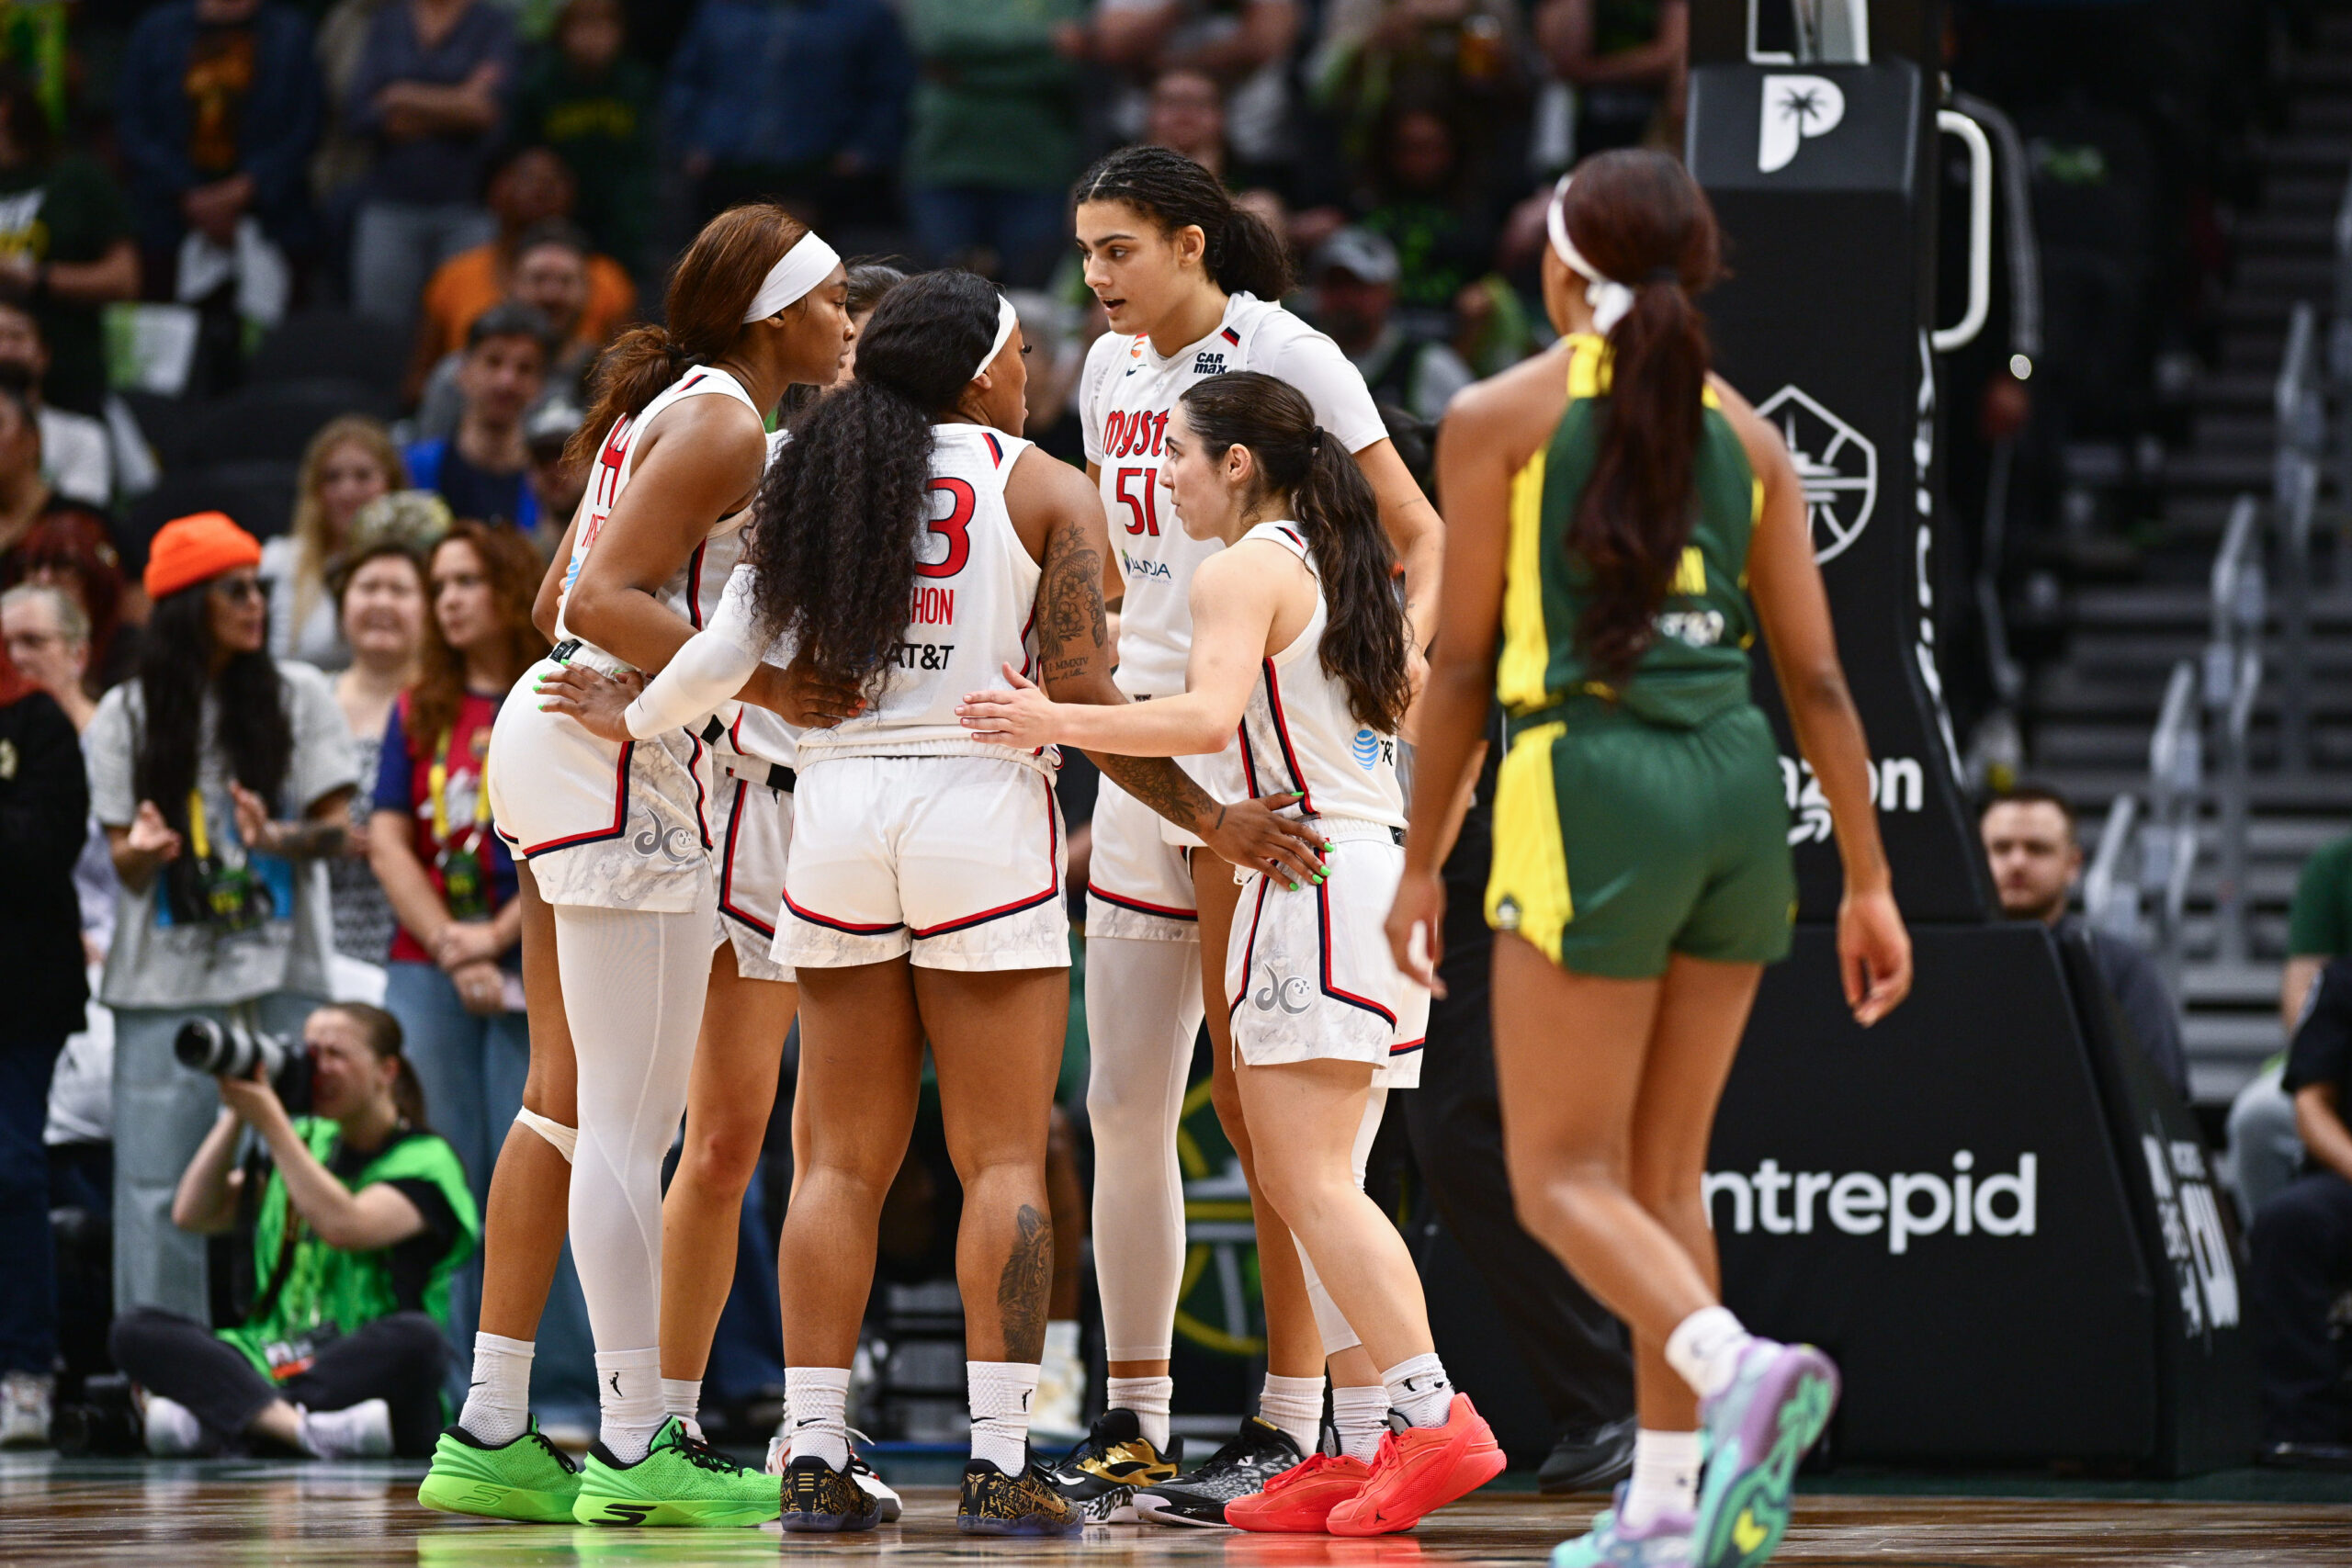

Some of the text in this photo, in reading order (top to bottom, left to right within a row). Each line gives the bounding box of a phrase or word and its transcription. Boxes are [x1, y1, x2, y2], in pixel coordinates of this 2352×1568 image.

[1193, 363, 1227, 375] max
[1196, 352, 1225, 364] CAR
[1103, 407, 1170, 458] myst
[1115, 467, 1160, 537] 51
[910, 587, 955, 626] HON
[888, 643, 955, 671] AT&T
[1701, 1149, 2038, 1255] ntrepid
